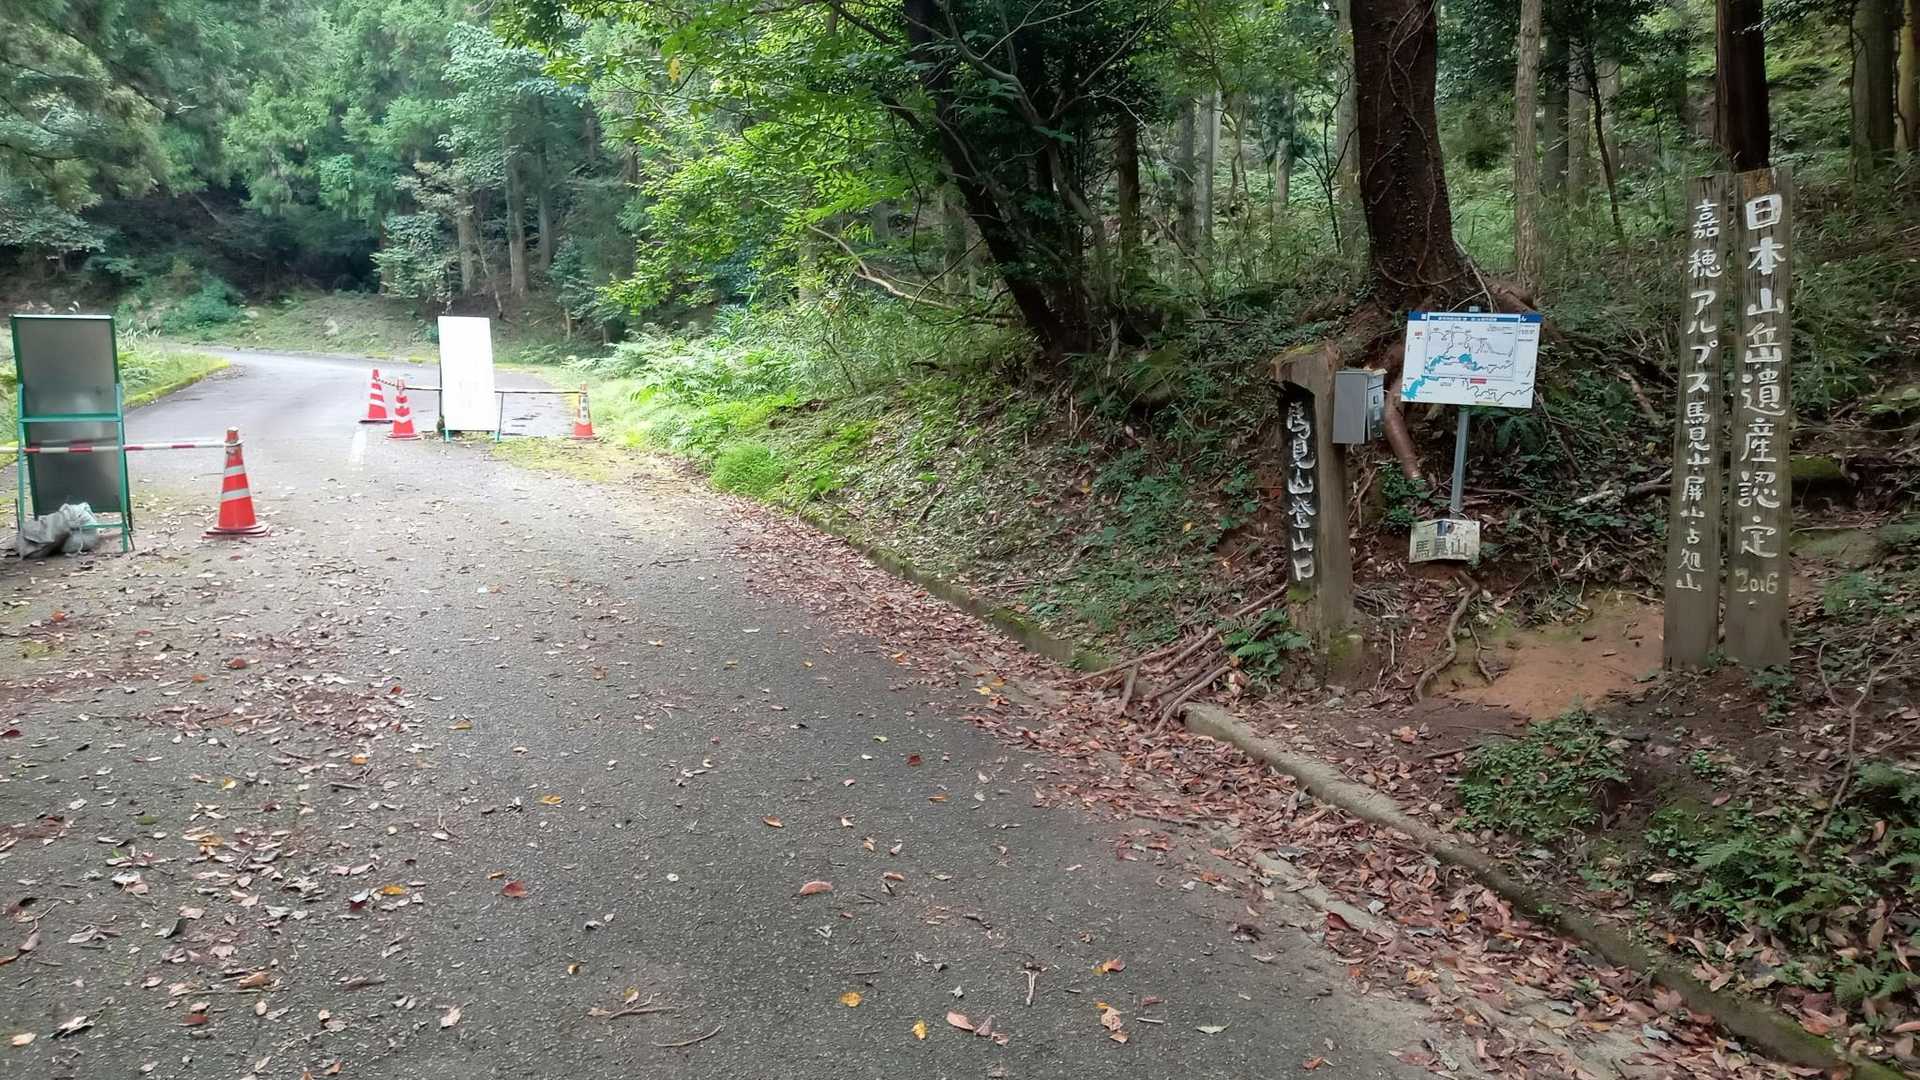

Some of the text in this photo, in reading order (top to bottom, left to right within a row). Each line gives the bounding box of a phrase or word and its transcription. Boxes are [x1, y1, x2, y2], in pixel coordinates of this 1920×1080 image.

[1738, 194, 1786, 558] 日本山岳遺産認定
[1735, 568, 1779, 594] 2016
